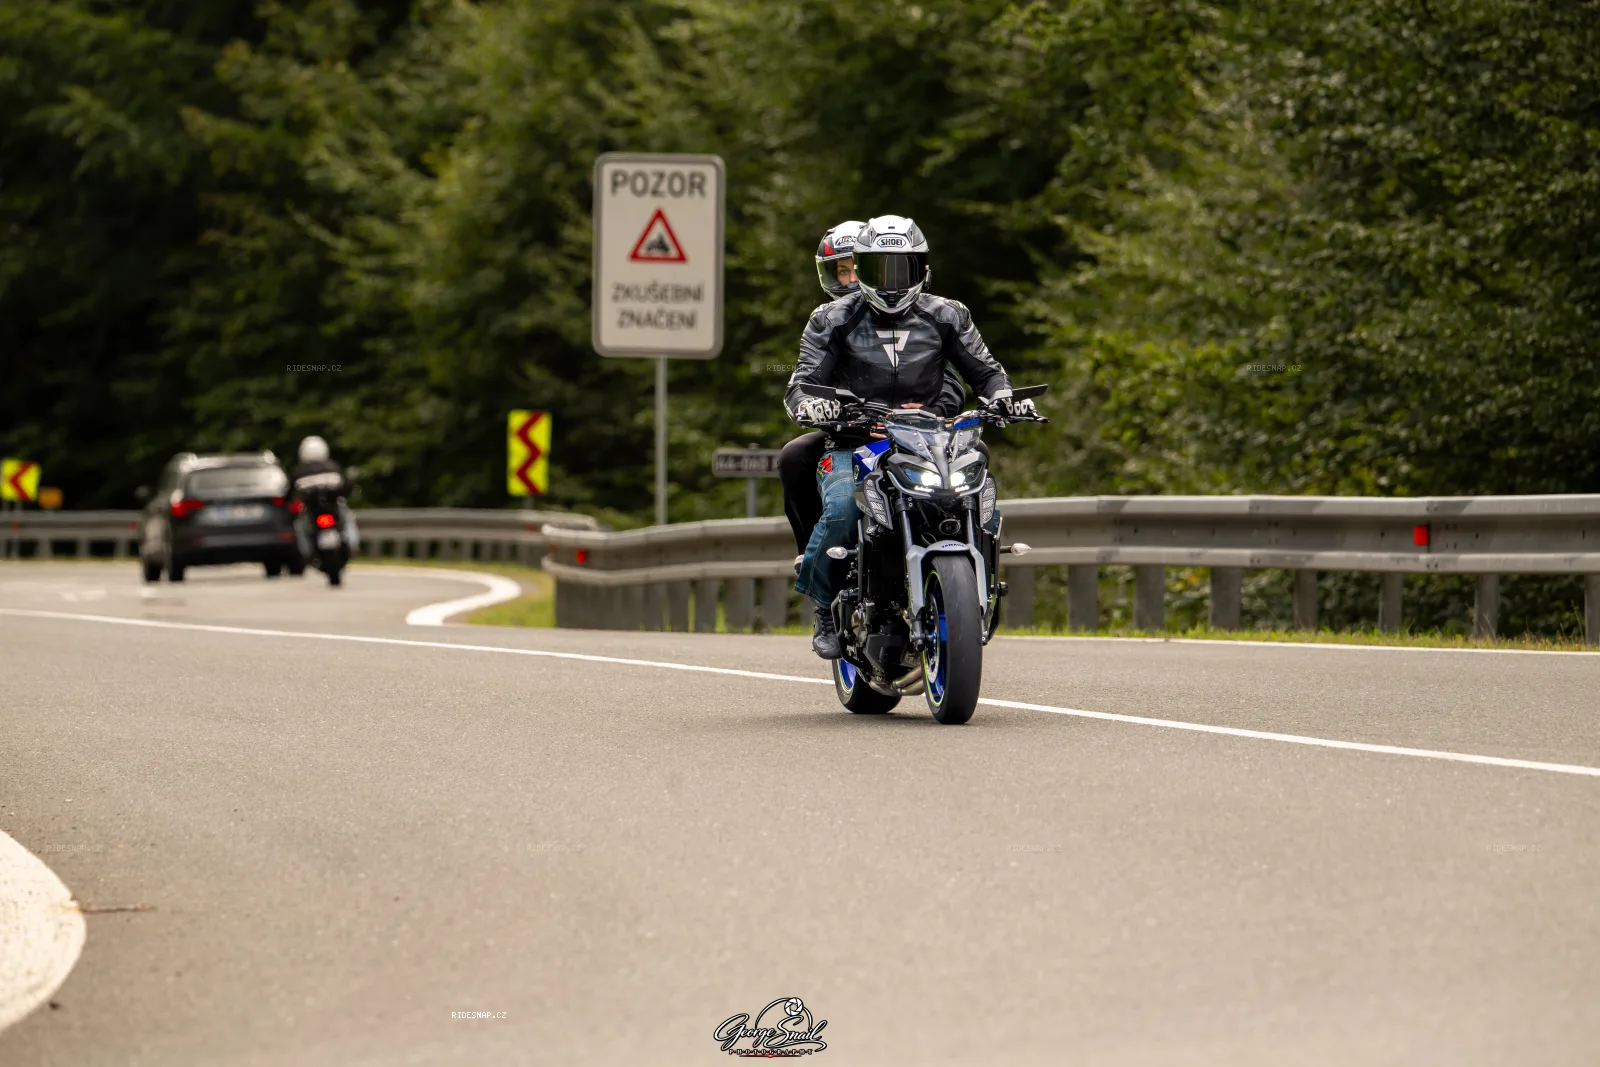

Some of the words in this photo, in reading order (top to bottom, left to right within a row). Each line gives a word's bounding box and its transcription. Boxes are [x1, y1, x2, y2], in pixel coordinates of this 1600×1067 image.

[611, 170, 706, 198] POZOR
[880, 238, 903, 246] SHOEI
[612, 280, 704, 303] ZKUŠEBNÍ
[617, 308, 699, 330] ZNAČENÍ
